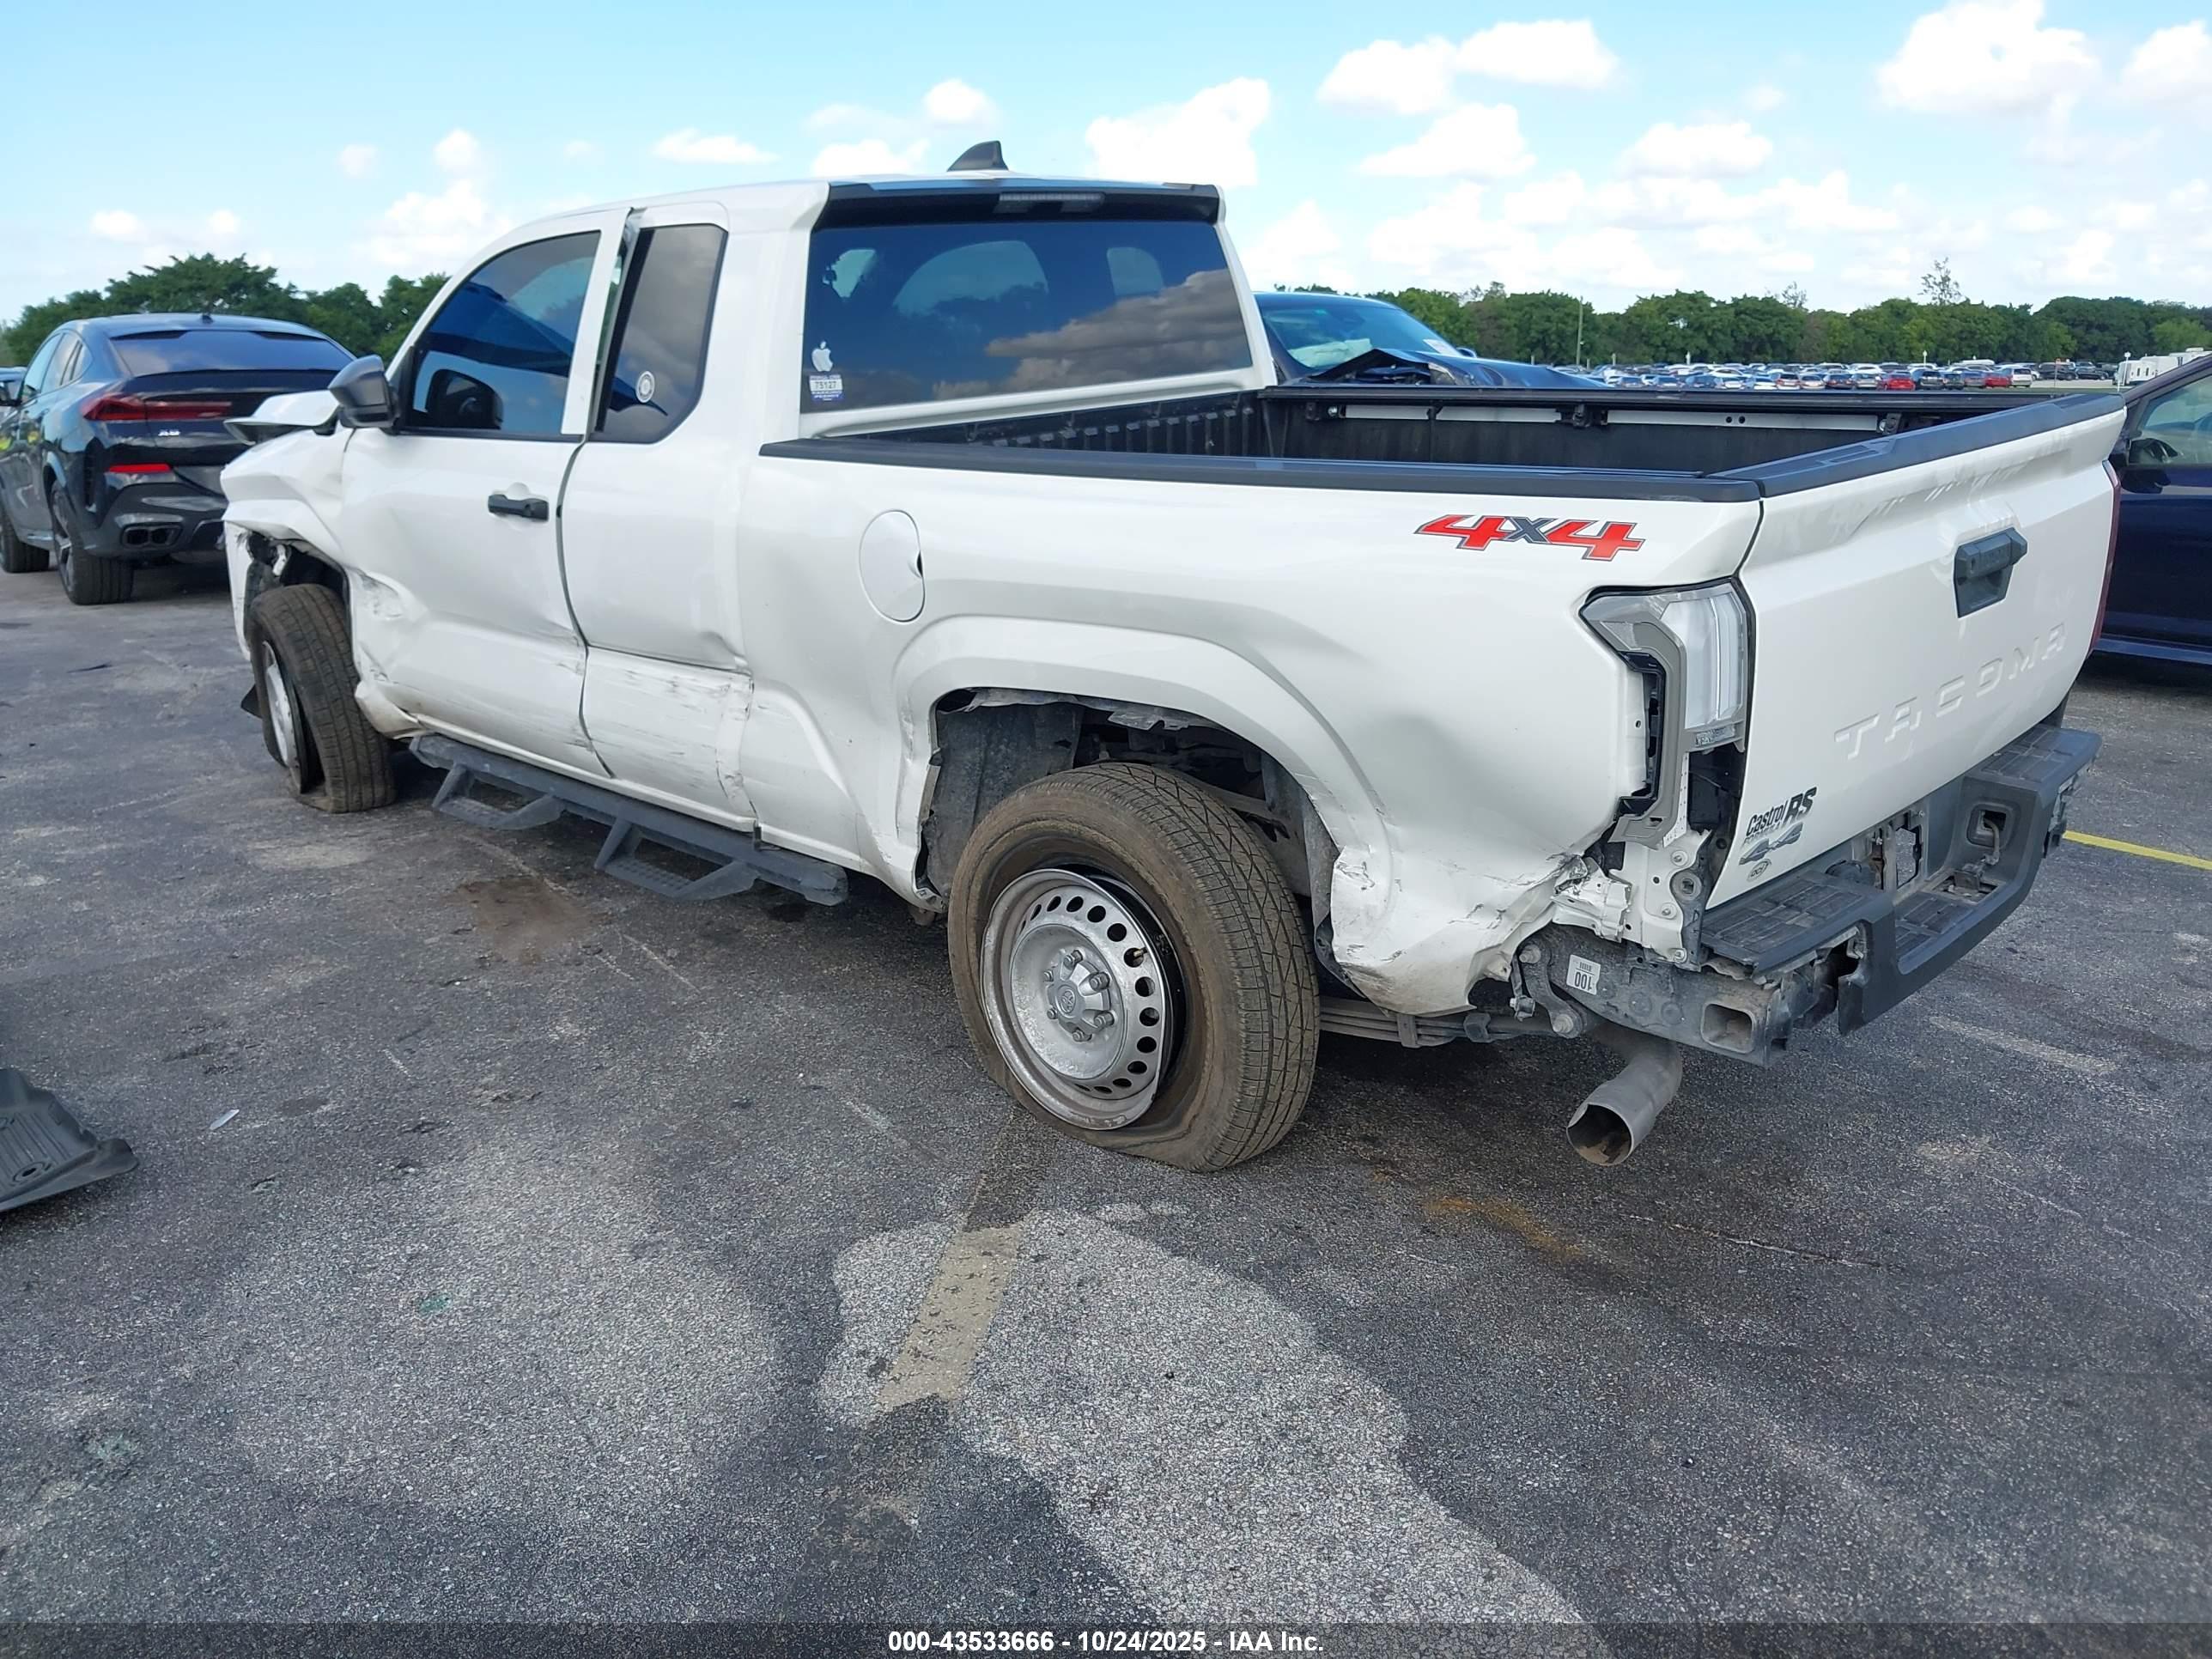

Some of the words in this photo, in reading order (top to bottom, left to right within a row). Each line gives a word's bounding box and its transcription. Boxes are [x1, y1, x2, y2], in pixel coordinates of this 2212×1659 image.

[1834, 623, 2068, 760] TACOMA
[1746, 799, 1789, 836] Castrol
[1574, 971, 1593, 991] 100
